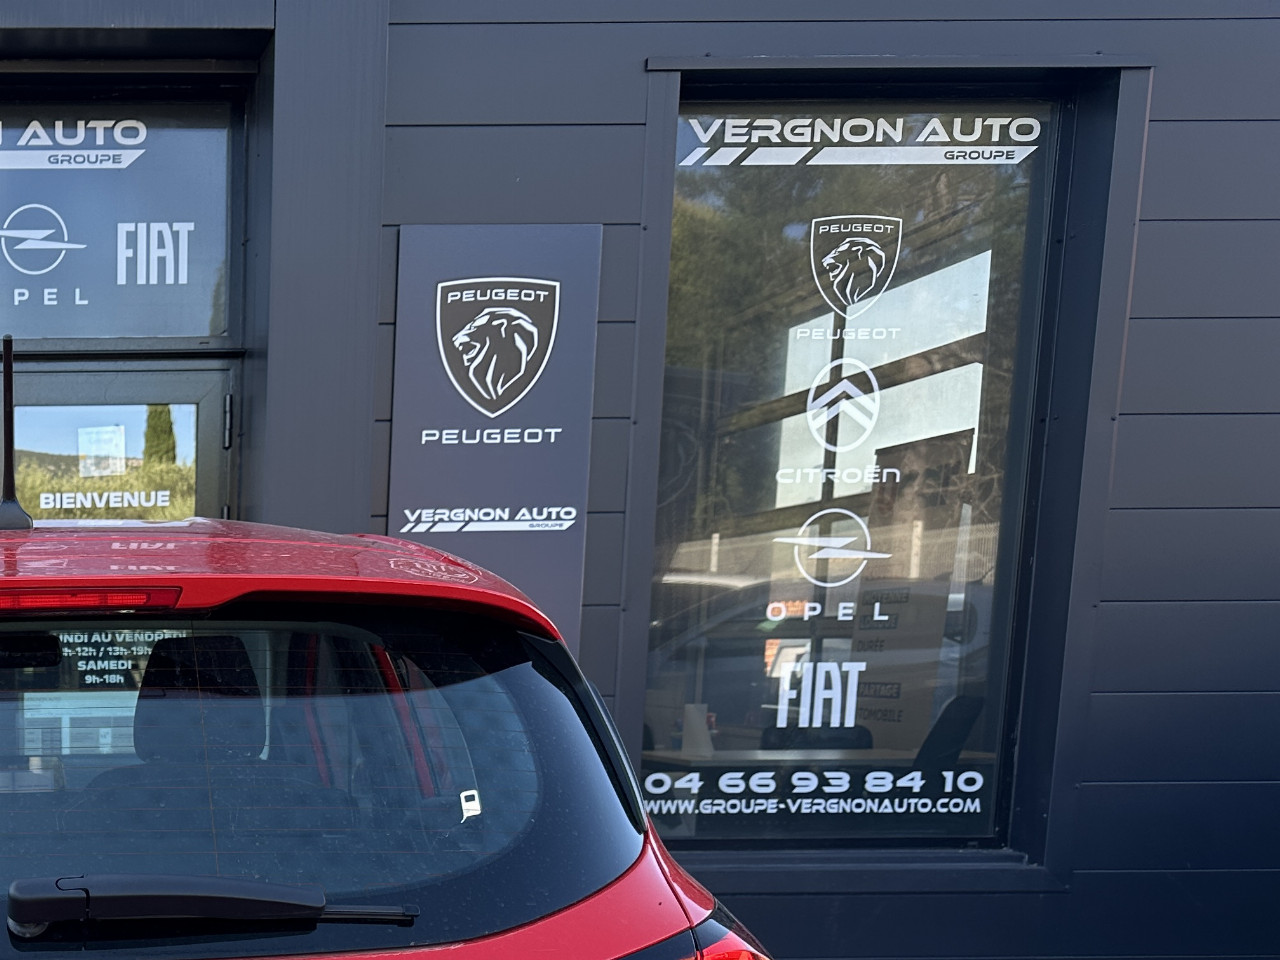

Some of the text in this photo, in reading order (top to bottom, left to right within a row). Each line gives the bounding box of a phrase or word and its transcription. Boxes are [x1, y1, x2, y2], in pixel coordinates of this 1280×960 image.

[16, 119, 148, 146] AUTO
[688, 117, 1042, 143] VERGNON AUTO
[47, 153, 123, 165] GROUPE
[943, 149, 1016, 161] GROUPE
[819, 223, 895, 234] PEUGEOT
[116, 221, 195, 285] FIAT
[447, 288, 549, 303] PEUGEOT
[796, 327, 902, 340] PEUGEOT
[421, 428, 563, 444] PEUGEOT
[775, 464, 902, 484] CITROËN
[39, 490, 170, 509] BIENVENUE
[403, 507, 577, 521] VERGNON AUTO
[766, 601, 889, 622] OPEL
[91, 632, 112, 643] AU
[77, 660, 132, 670] SAMEDI
[84, 674, 125, 684] 9h-18h
[775, 661, 867, 728] FIAT
[644, 771, 985, 794] 04 66 93 84 10
[644, 798, 981, 814] WWW.GROUPE-VERGNONAUTO.COM
